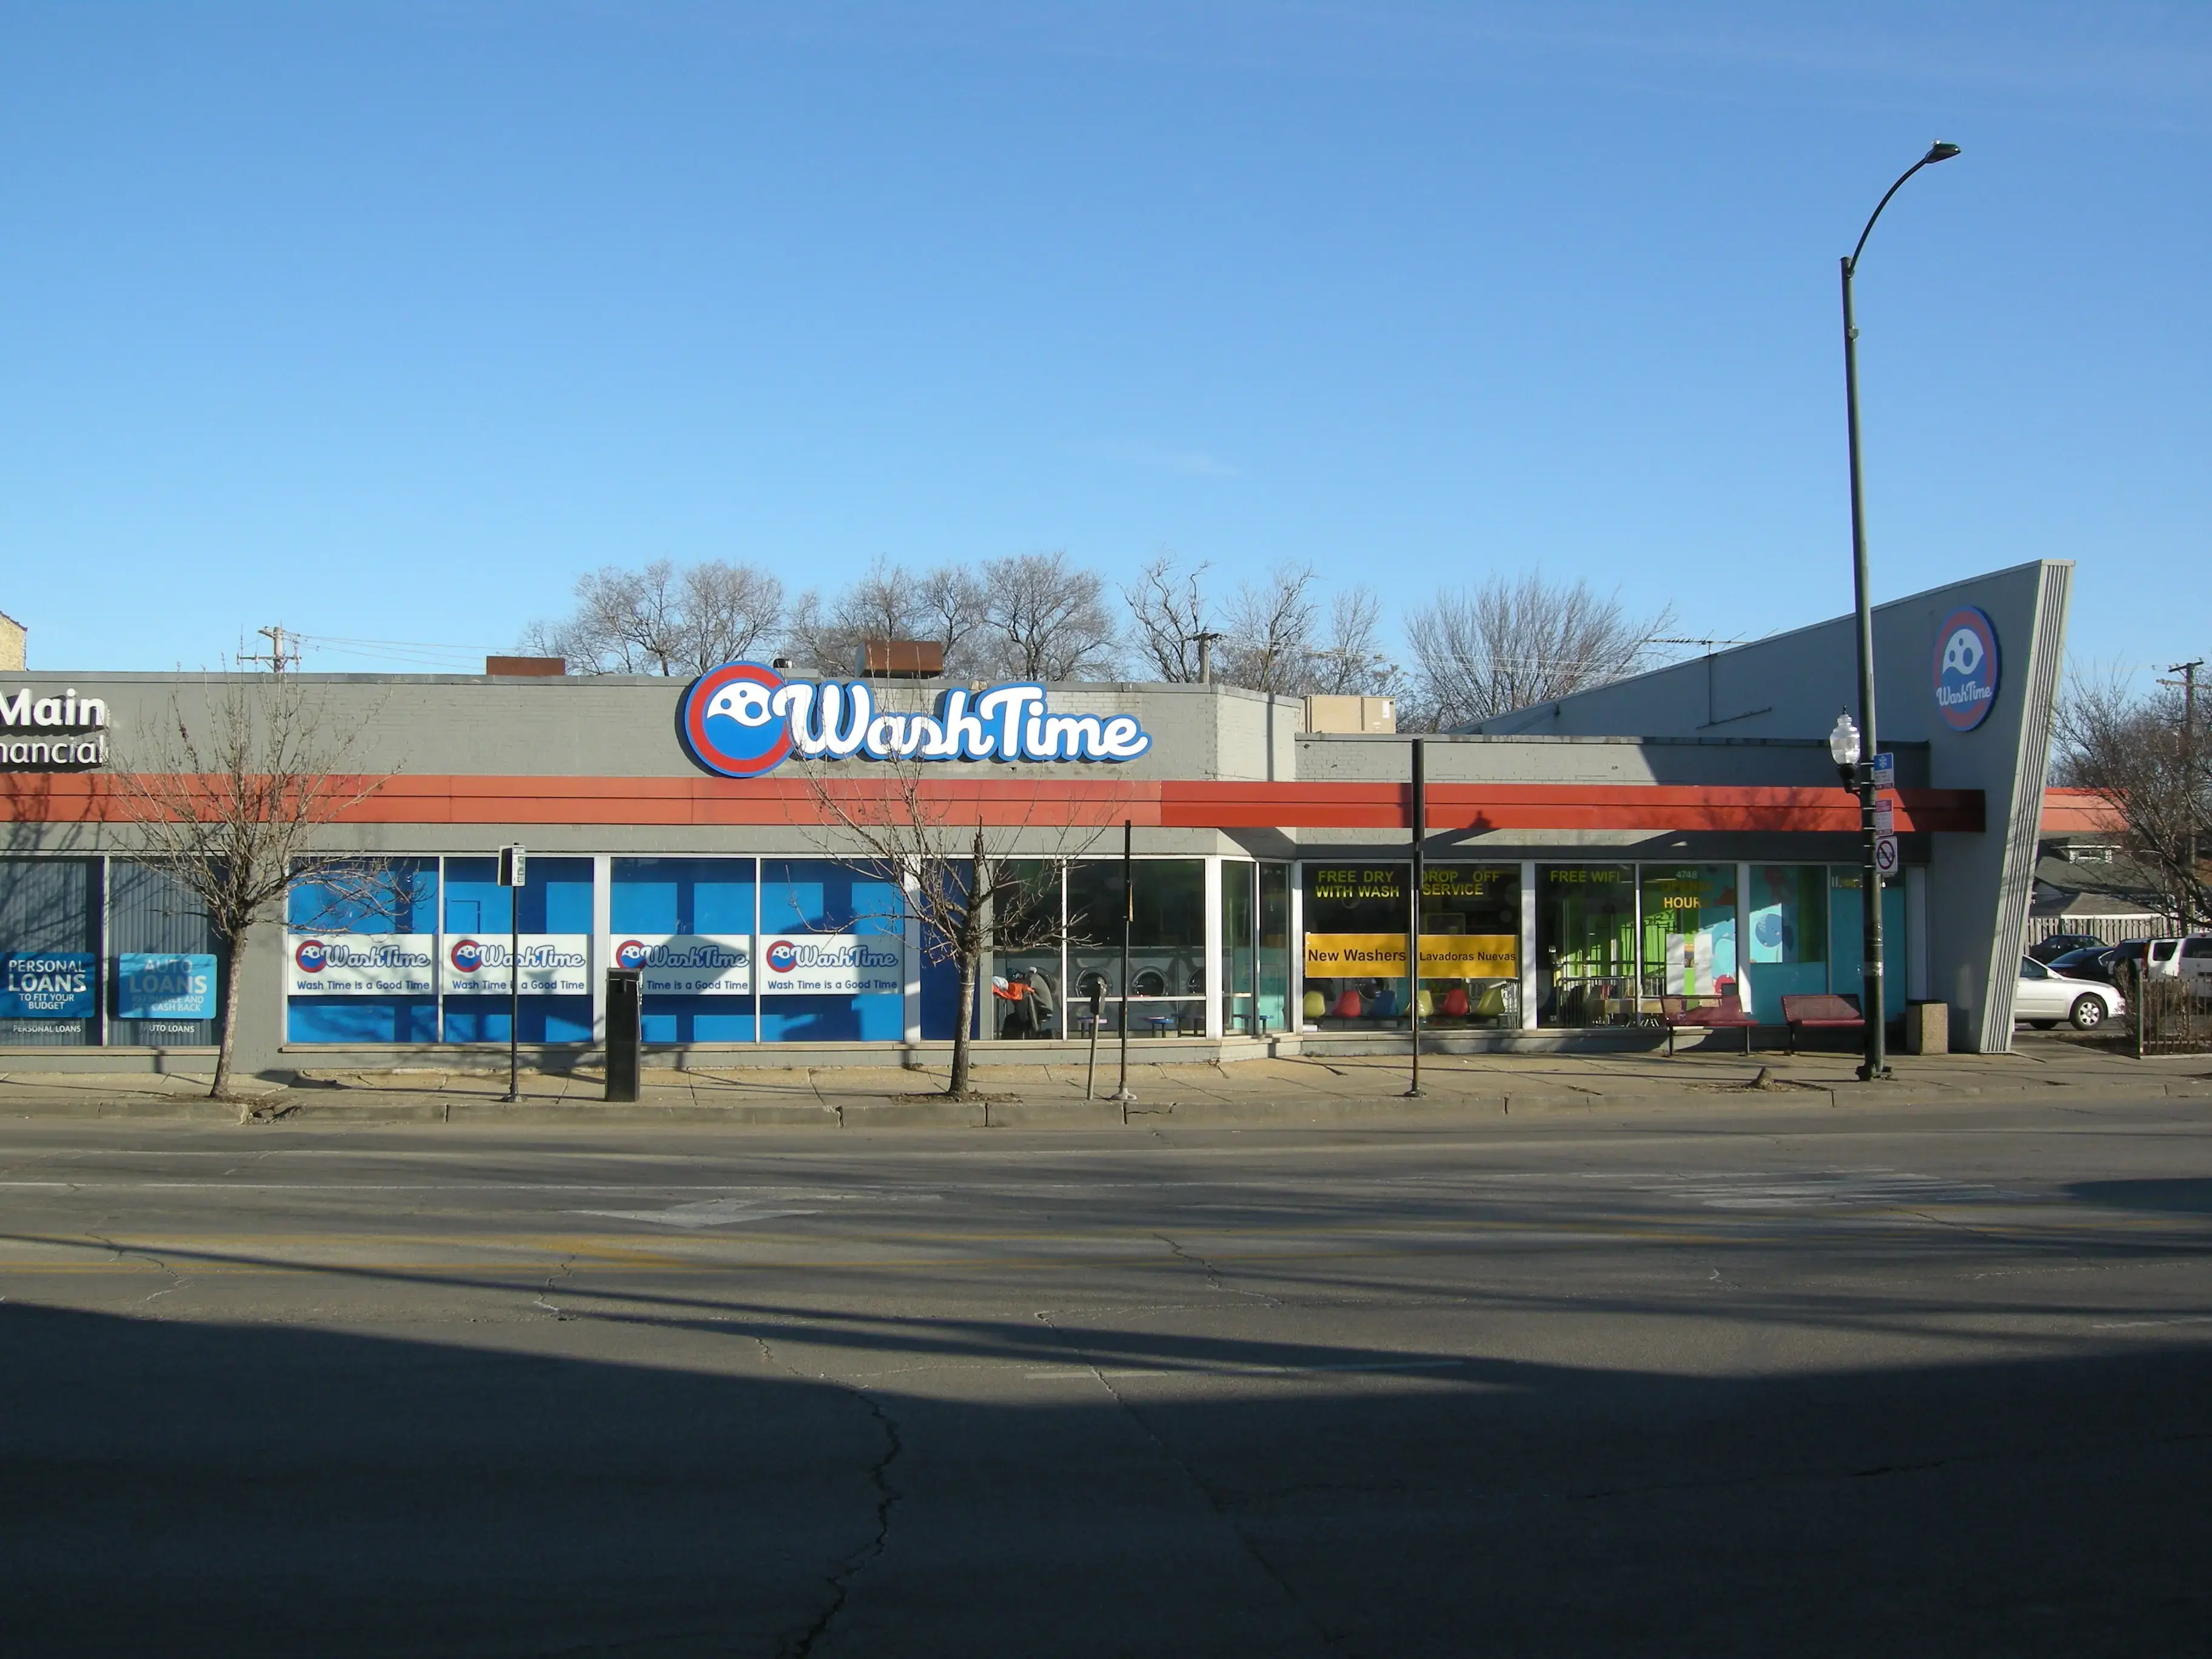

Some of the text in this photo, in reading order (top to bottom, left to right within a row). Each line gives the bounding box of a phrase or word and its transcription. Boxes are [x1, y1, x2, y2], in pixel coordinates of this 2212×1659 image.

[0, 688, 106, 726] Main
[1318, 870, 1393, 883] FREE DRY
[1473, 871, 1500, 882] OFF
[1550, 870, 1620, 883] FREE WIFI
[1316, 886, 1399, 897] WITH WASH
[1423, 883, 1484, 896] SERVICE
[1663, 897, 1710, 908] HOUR
[1308, 949, 1406, 961] New Washers
[1419, 951, 1516, 961] Lavadoras Nuevas
[9, 960, 85, 973] PERSONAL
[145, 959, 193, 973] AUTO
[8, 973, 87, 993] LOANS
[129, 974, 207, 994] LOANS
[297, 980, 324, 990] Wash
[327, 980, 352, 990] Time
[355, 980, 363, 990] is
[376, 980, 403, 990] Good
[406, 980, 430, 990] Time
[452, 980, 479, 990] Wash
[483, 980, 506, 990] Time
[531, 980, 557, 990] Good
[560, 980, 585, 990] Time
[647, 980, 671, 990] Time
[674, 980, 682, 990] is
[695, 980, 722, 990] Good
[725, 980, 748, 990] Time
[768, 980, 794, 990] Wash
[797, 980, 821, 990] Time
[825, 980, 832, 990] is
[845, 980, 871, 990] Good
[874, 980, 898, 990] Time
[50, 993, 74, 1002] YOUR
